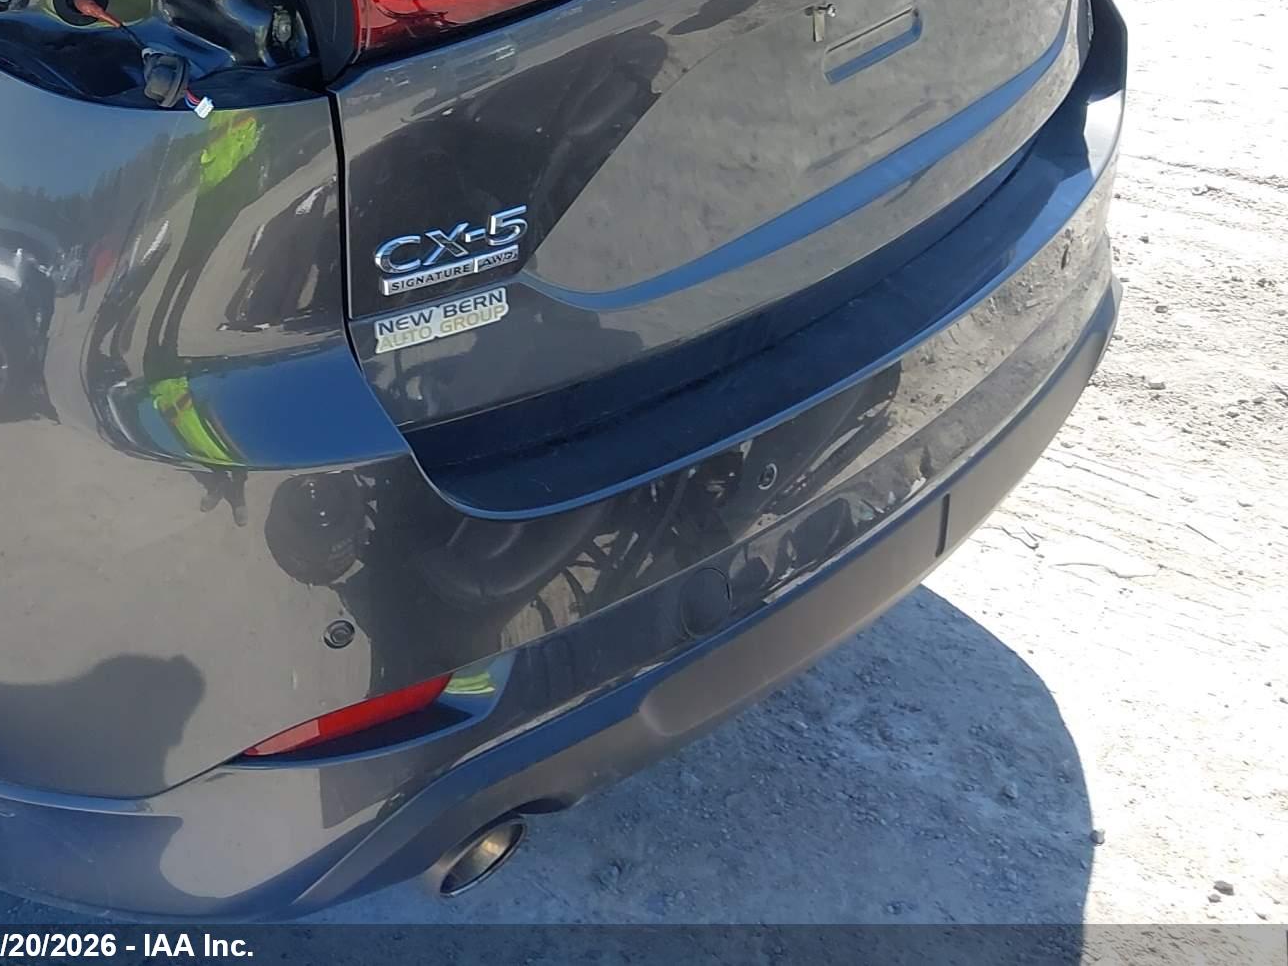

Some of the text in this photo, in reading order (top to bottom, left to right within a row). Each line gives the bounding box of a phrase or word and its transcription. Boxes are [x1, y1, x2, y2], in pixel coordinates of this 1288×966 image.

[374, 205, 528, 273] CX-5
[391, 250, 518, 291] SIGNATURE AWD
[378, 290, 503, 336] NEW BERN
[379, 305, 505, 351] AUTO GROUP
